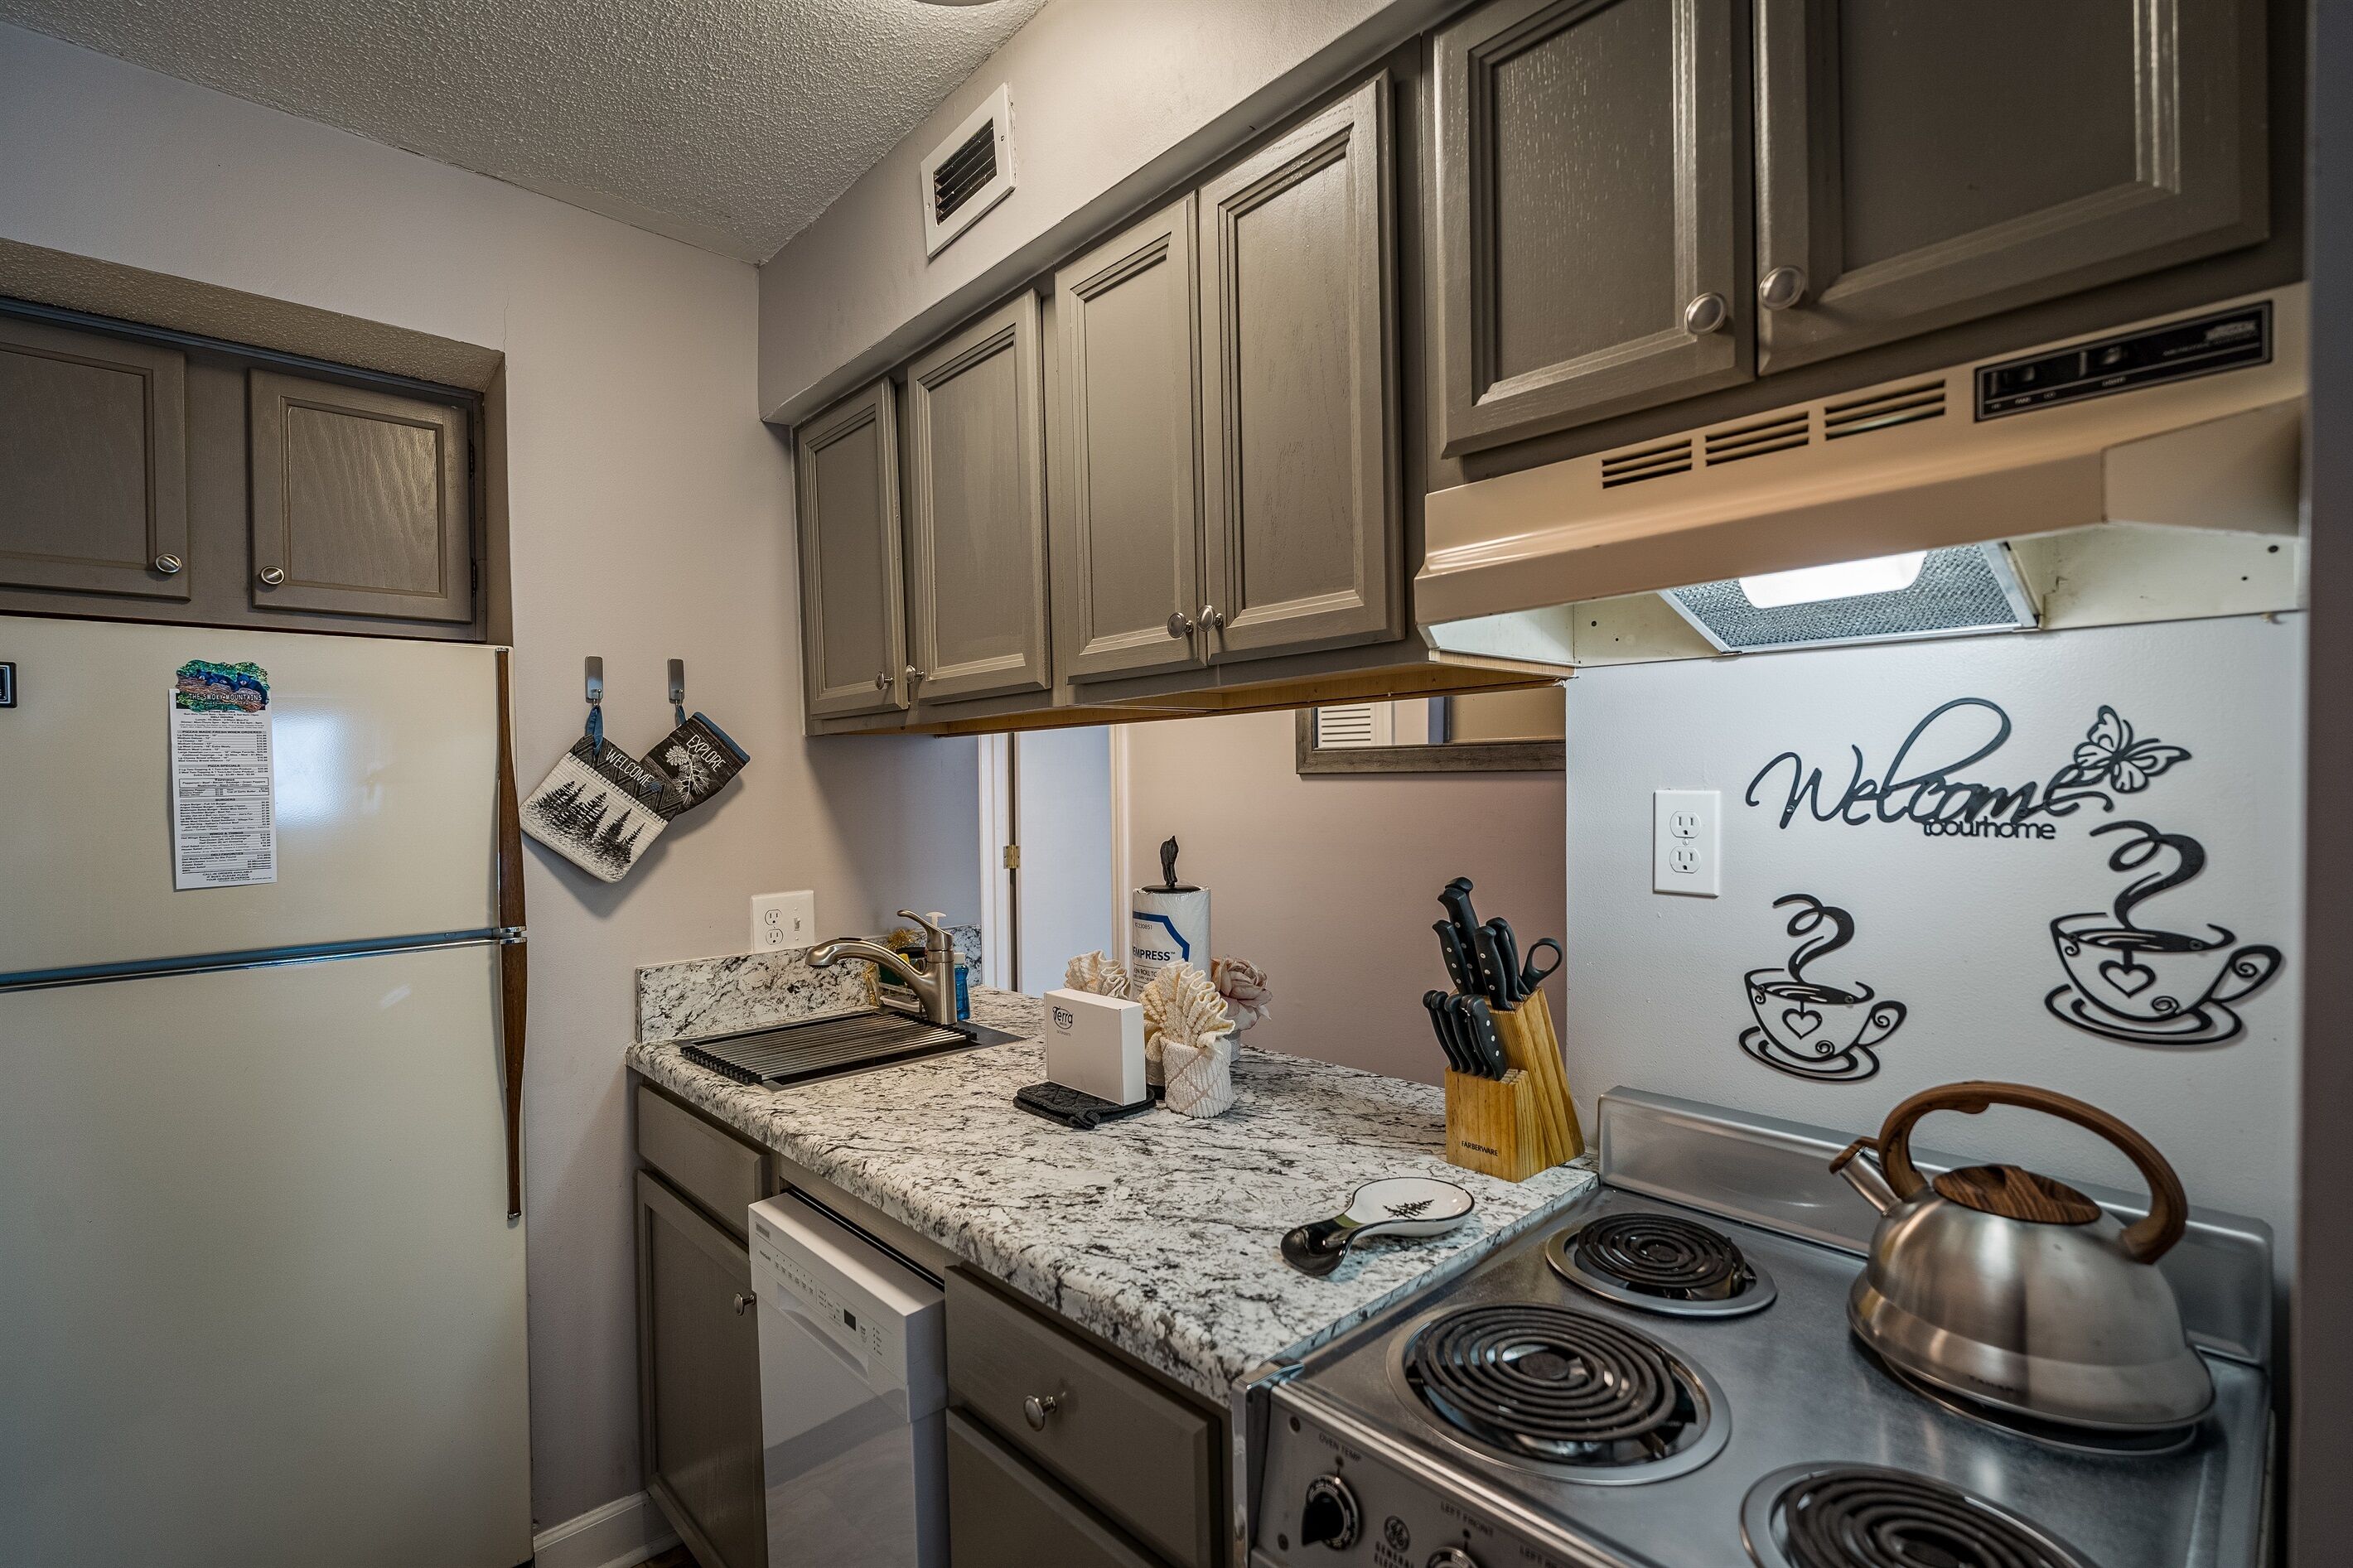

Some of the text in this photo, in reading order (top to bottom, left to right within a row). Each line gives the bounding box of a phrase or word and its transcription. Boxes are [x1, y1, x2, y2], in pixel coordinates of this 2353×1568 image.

[606, 749, 655, 787] WELCOME
[686, 734, 726, 772] EXPLORE
[1745, 697, 2114, 829] Welcome
[1052, 1006, 1074, 1023] Terra
[1461, 1141, 1498, 1156] FARBERWARE
